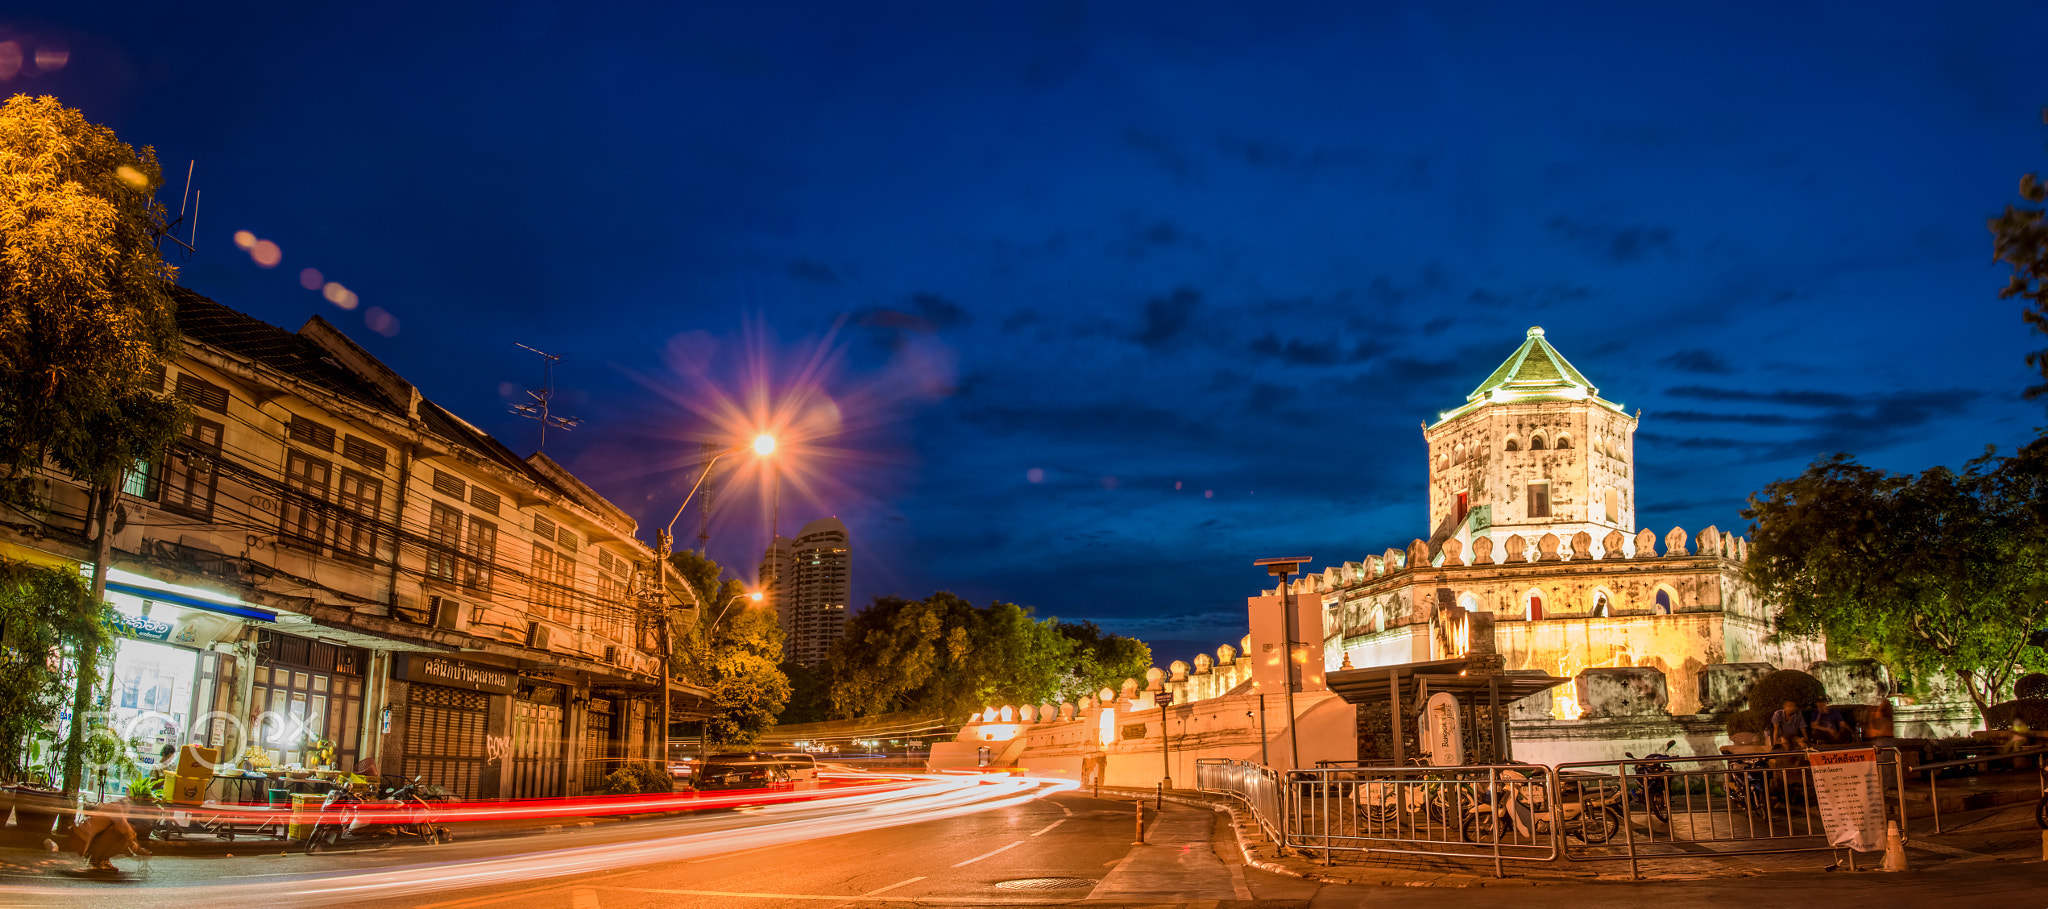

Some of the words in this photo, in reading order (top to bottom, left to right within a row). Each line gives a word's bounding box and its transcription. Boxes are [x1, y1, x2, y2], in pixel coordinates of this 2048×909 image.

[424, 658, 507, 690] คลินิกบ้านคุณหมอ
[1442, 721, 1450, 748] Bangkok
